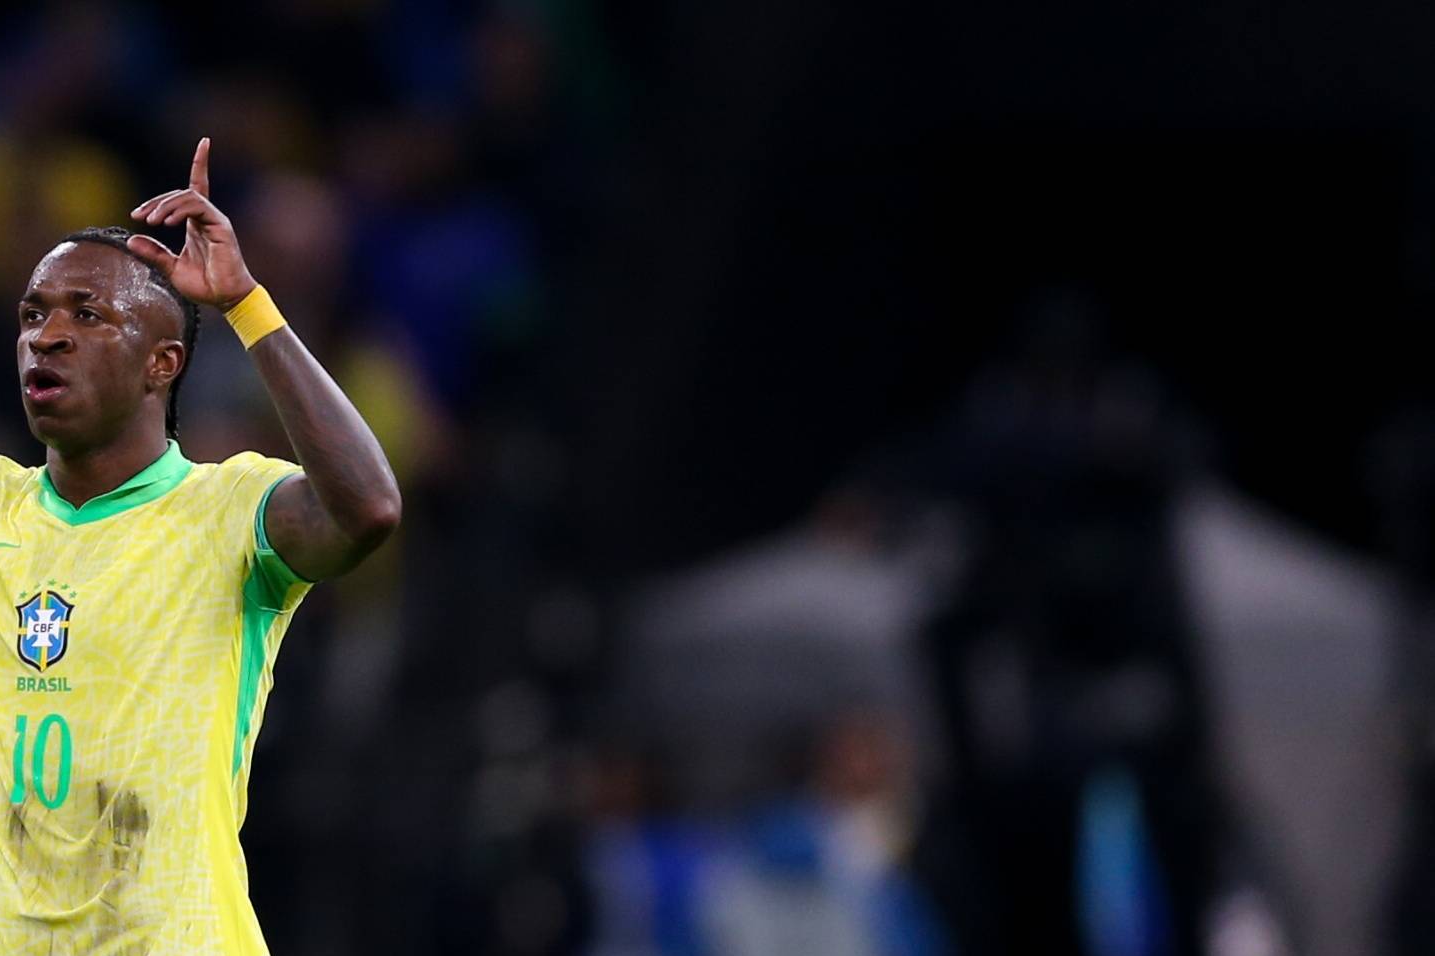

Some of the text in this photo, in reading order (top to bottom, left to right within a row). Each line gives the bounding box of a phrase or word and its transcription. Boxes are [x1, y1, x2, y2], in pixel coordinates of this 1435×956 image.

[32, 622, 54, 634] CBF
[16, 676, 72, 692] BRASIL
[9, 713, 72, 810] 10
